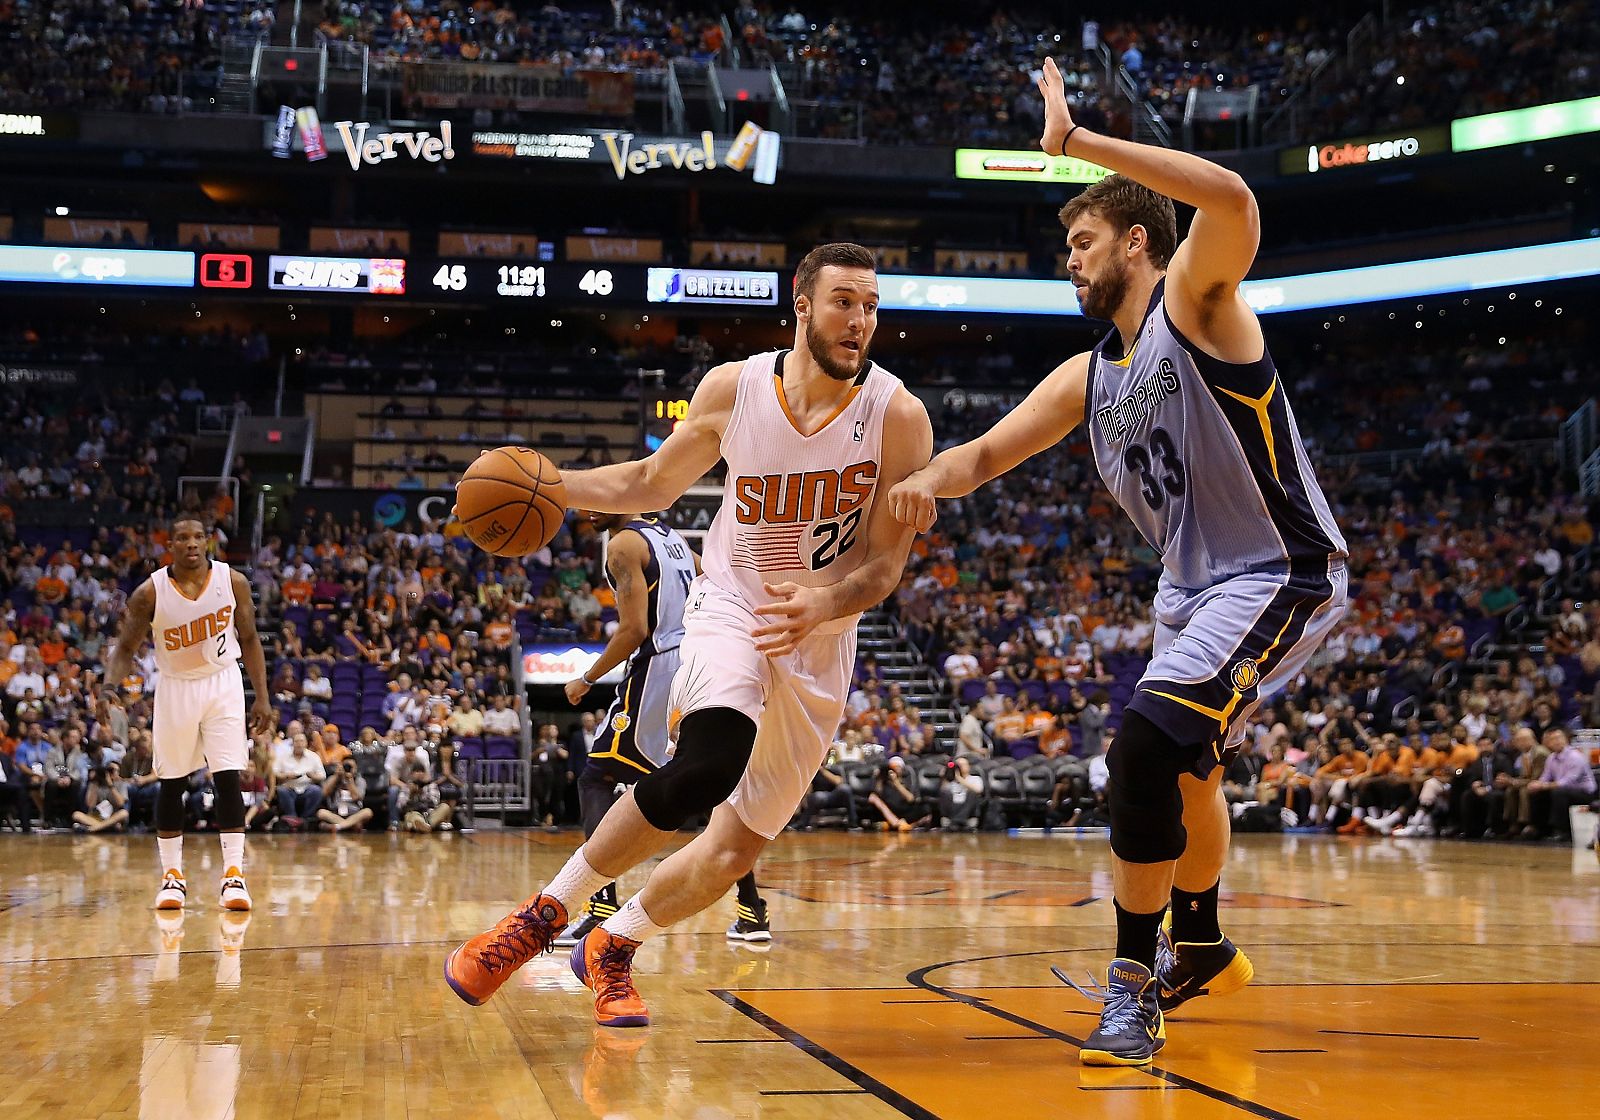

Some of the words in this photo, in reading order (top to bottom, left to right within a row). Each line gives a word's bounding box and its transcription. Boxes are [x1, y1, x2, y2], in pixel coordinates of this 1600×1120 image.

[333, 120, 455, 171] Verve!
[600, 130, 717, 181] Verve!
[432, 265, 468, 291] 45
[498, 266, 545, 285] 11:01
[578, 269, 614, 296] 46
[686, 276, 770, 298] GRIZZLIES
[1096, 357, 1180, 445] MEMPHIS
[1124, 427, 1186, 511] 33
[735, 459, 878, 526] SUNS
[811, 507, 863, 572] 22
[163, 605, 232, 651] SUNS
[216, 632, 227, 658] 2
[1112, 966, 1146, 983] MARC
